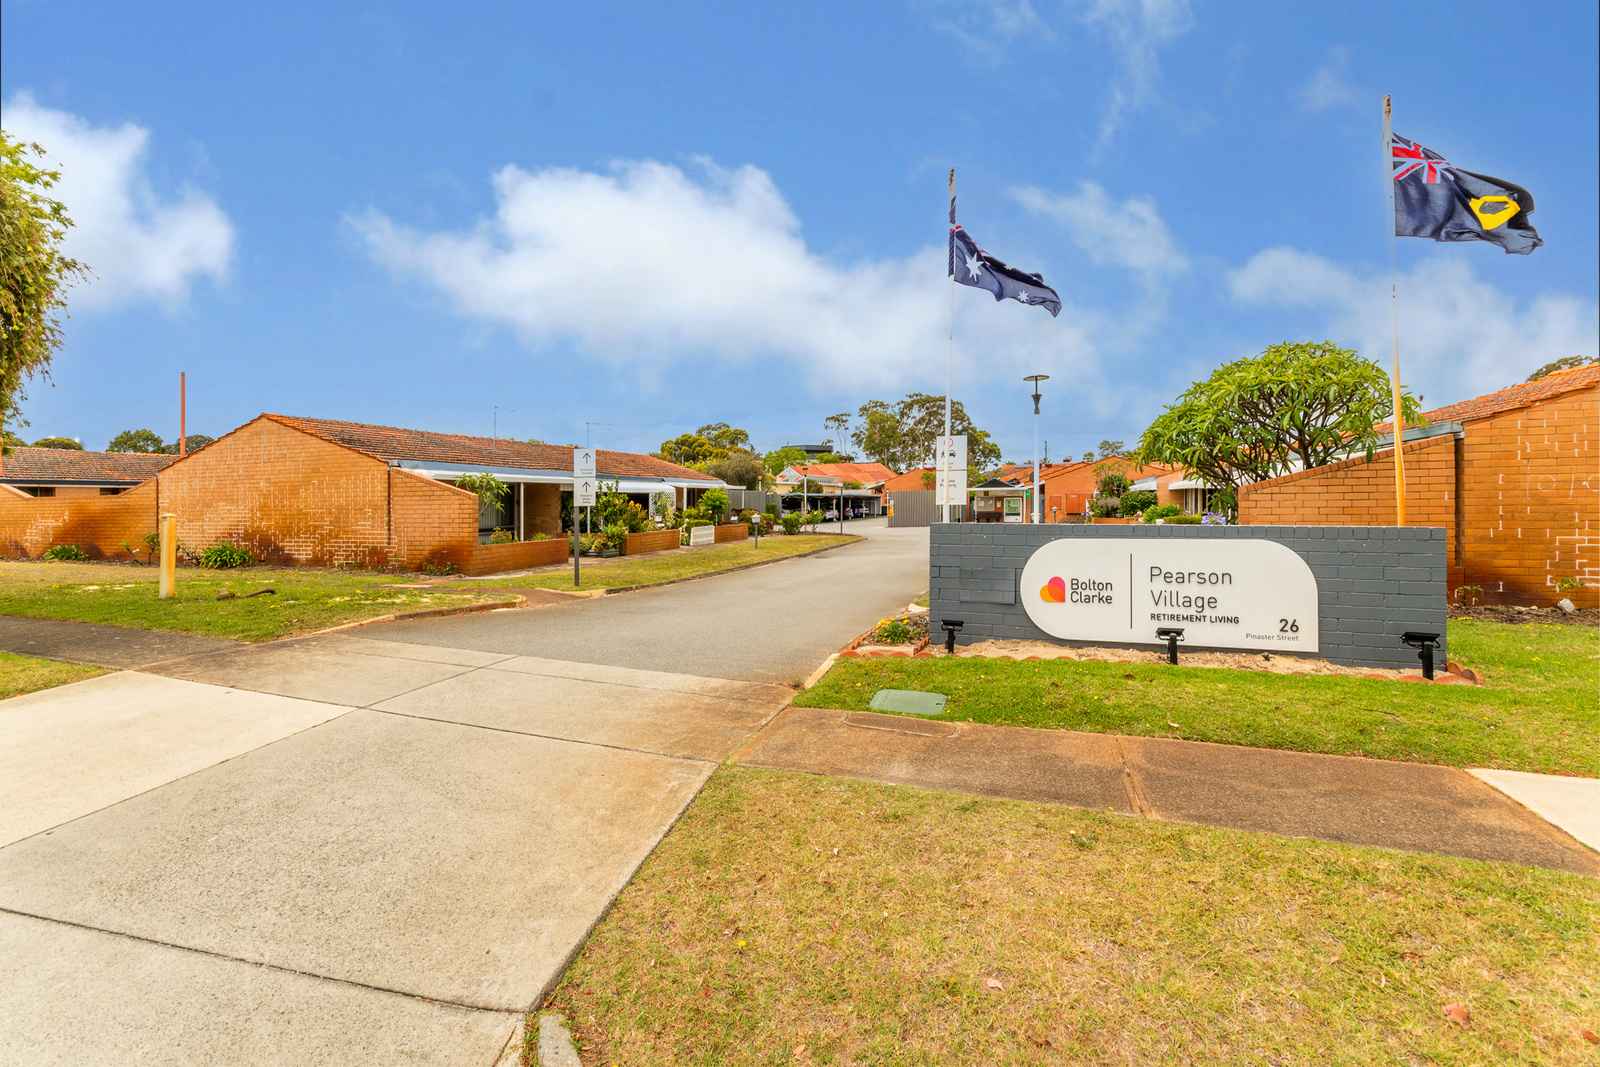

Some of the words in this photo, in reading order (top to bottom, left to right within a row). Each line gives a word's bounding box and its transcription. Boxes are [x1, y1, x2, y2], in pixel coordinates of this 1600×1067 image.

[1150, 566, 1232, 585] Pearson
[1071, 578, 1113, 591] Bolton
[1070, 591, 1113, 604] Clarke
[1150, 589, 1218, 613] Village
[1150, 613, 1208, 624] RETIREMENT
[1209, 615, 1240, 625] LIVING
[1279, 618, 1300, 633] 26
